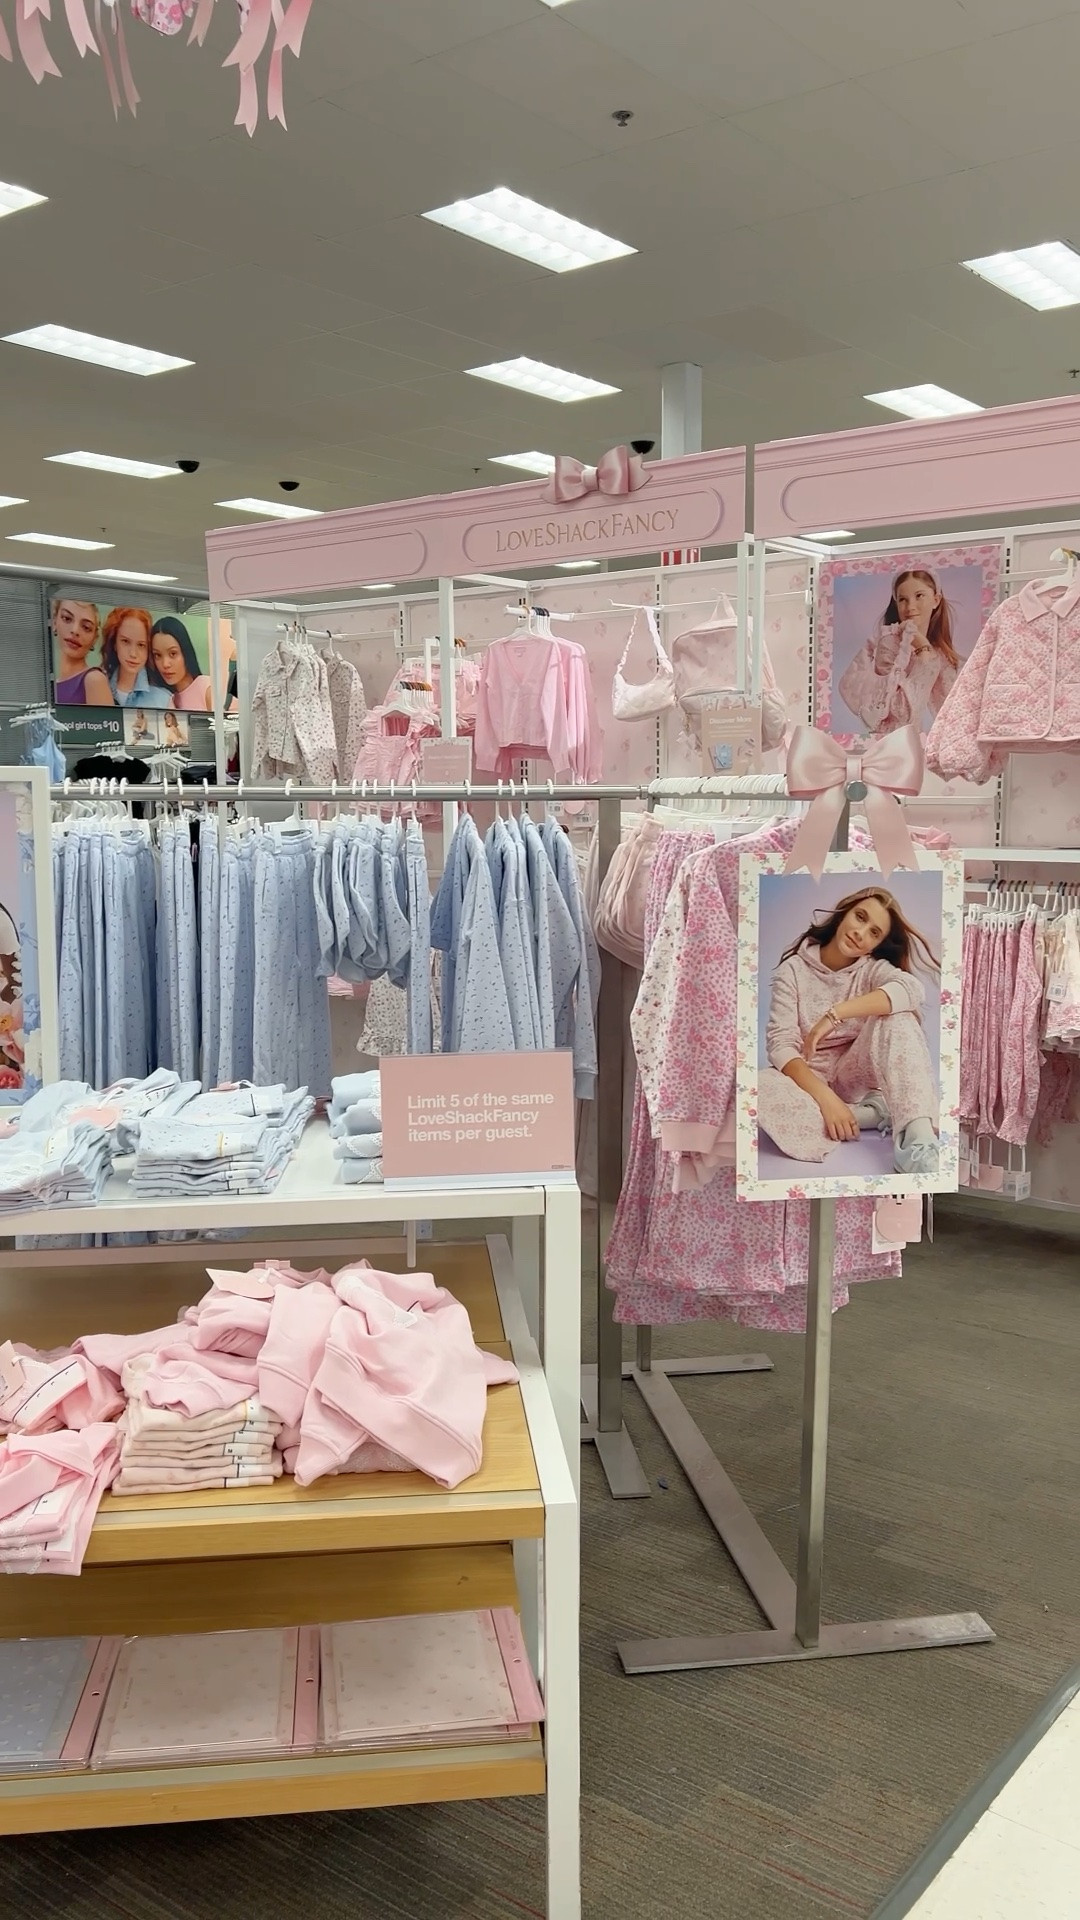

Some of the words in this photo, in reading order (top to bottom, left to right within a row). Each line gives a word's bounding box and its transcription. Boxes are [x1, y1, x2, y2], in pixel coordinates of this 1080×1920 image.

[75, 722, 86, 730] girl
[103, 721, 119, 732] $10
[408, 1095, 446, 1108] Limit
[450, 1094, 459, 1107] 5
[463, 1093, 479, 1107] of
[483, 1093, 507, 1106] the
[511, 1093, 554, 1105] same
[408, 1109, 539, 1125] LoveShackFancy
[409, 1128, 451, 1142] items
[455, 1128, 481, 1143] per
[486, 1125, 532, 1142] guest.
